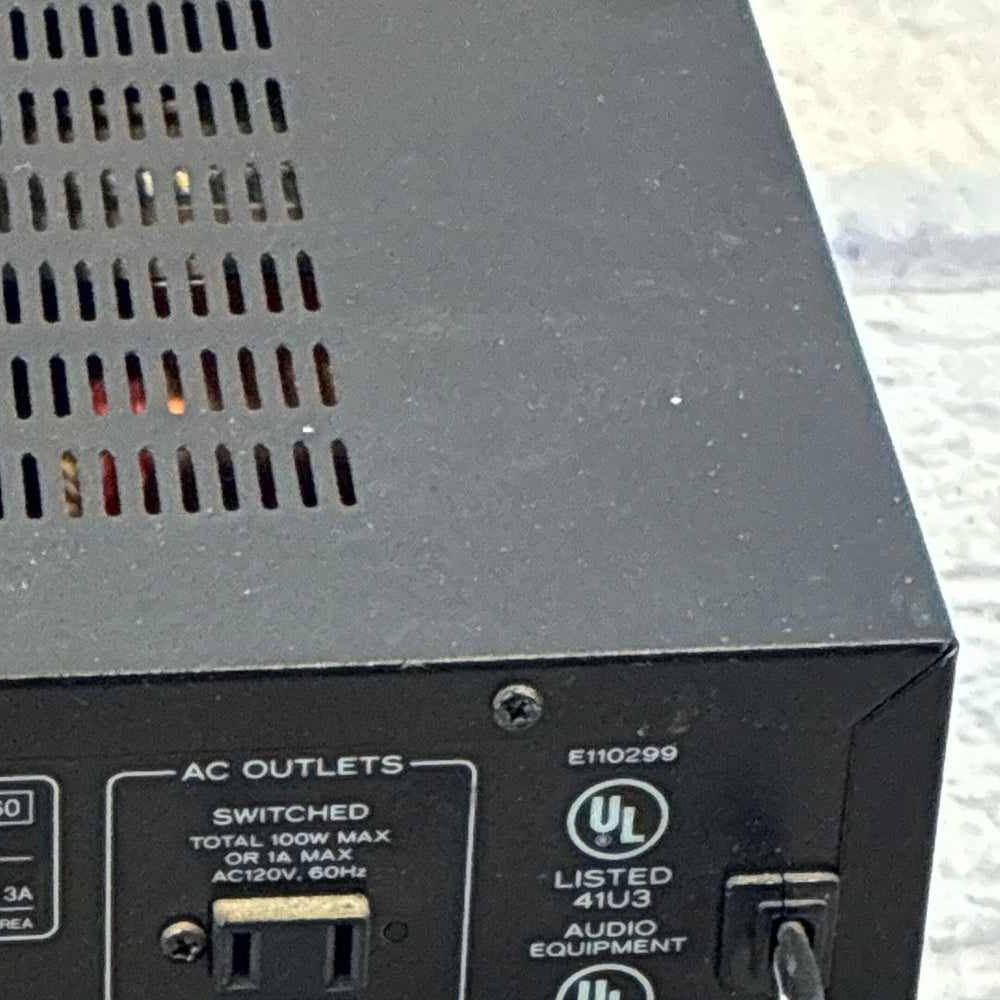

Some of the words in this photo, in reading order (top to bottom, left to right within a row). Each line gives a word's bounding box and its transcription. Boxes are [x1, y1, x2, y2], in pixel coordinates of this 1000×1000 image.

[567, 745, 678, 765] E110299
[181, 761, 230, 782] AC
[242, 755, 404, 779] OUTLETS
[212, 804, 370, 826] SWITCHED
[189, 833, 264, 850] TOTAL
[271, 832, 329, 846] 100W
[337, 829, 392, 844] MAX
[224, 852, 259, 866] OR
[268, 851, 291, 864] 1A
[301, 848, 353, 862] MAX
[308, 866, 367, 880] 60Hz
[554, 866, 674, 889] LISTED
[3, 886, 34, 902] 3A
[572, 889, 652, 910] 41U3
[563, 920, 658, 939] AUDIO
[529, 937, 688, 958] EQUIPMENT
